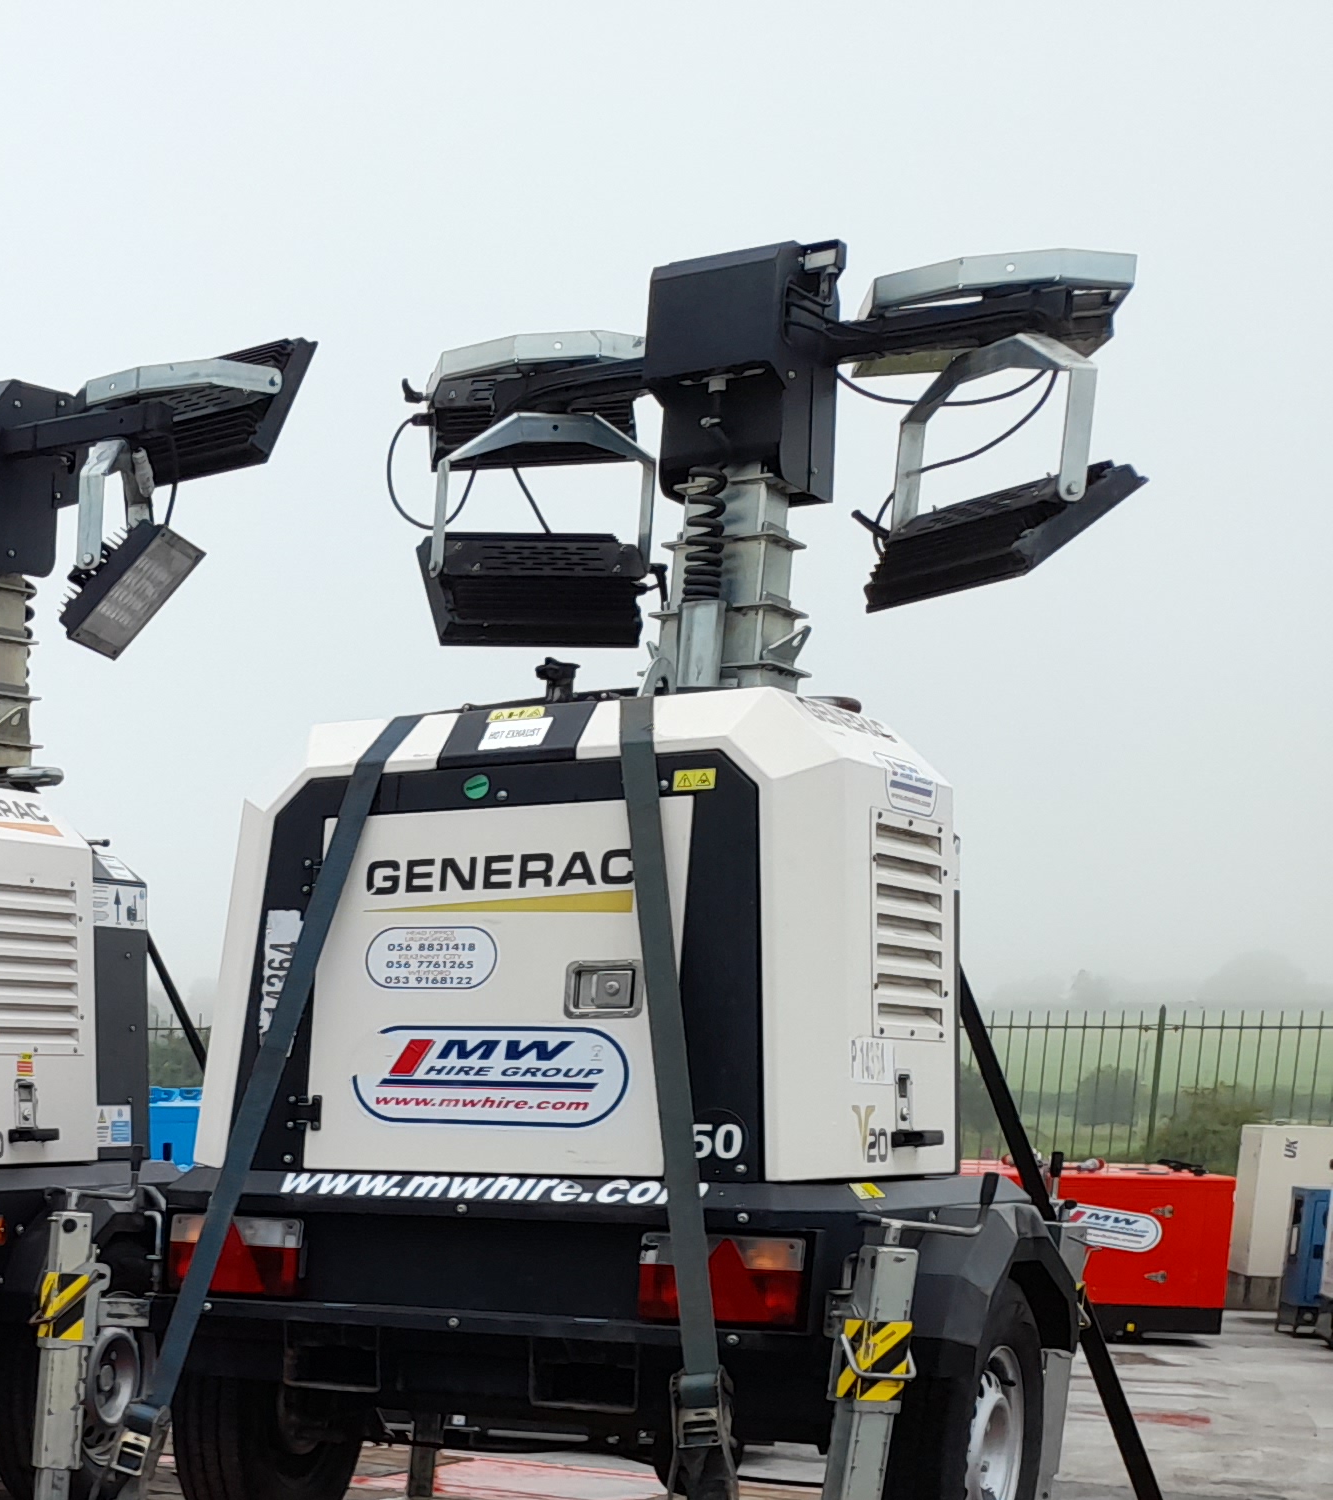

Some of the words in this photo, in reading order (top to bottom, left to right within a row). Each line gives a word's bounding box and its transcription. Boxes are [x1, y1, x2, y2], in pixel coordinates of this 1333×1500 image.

[367, 848, 635, 896] GENERAC
[387, 943, 413, 952] 056
[417, 943, 476, 952] 8831418
[385, 960, 412, 969] 056
[417, 960, 474, 969] 7761265
[384, 976, 410, 985] 053
[414, 976, 473, 985] 9168122
[435, 1039, 576, 1061] MW
[423, 1065, 496, 1078] HIRE
[499, 1066, 605, 1079] GROUP
[374, 1096, 590, 1111] www.mwhire.com
[851, 1104, 888, 1163] V20
[693, 1123, 743, 1160] 50
[1284, 1137, 1299, 1159] UK
[1086, 1212, 1141, 1226] MW
